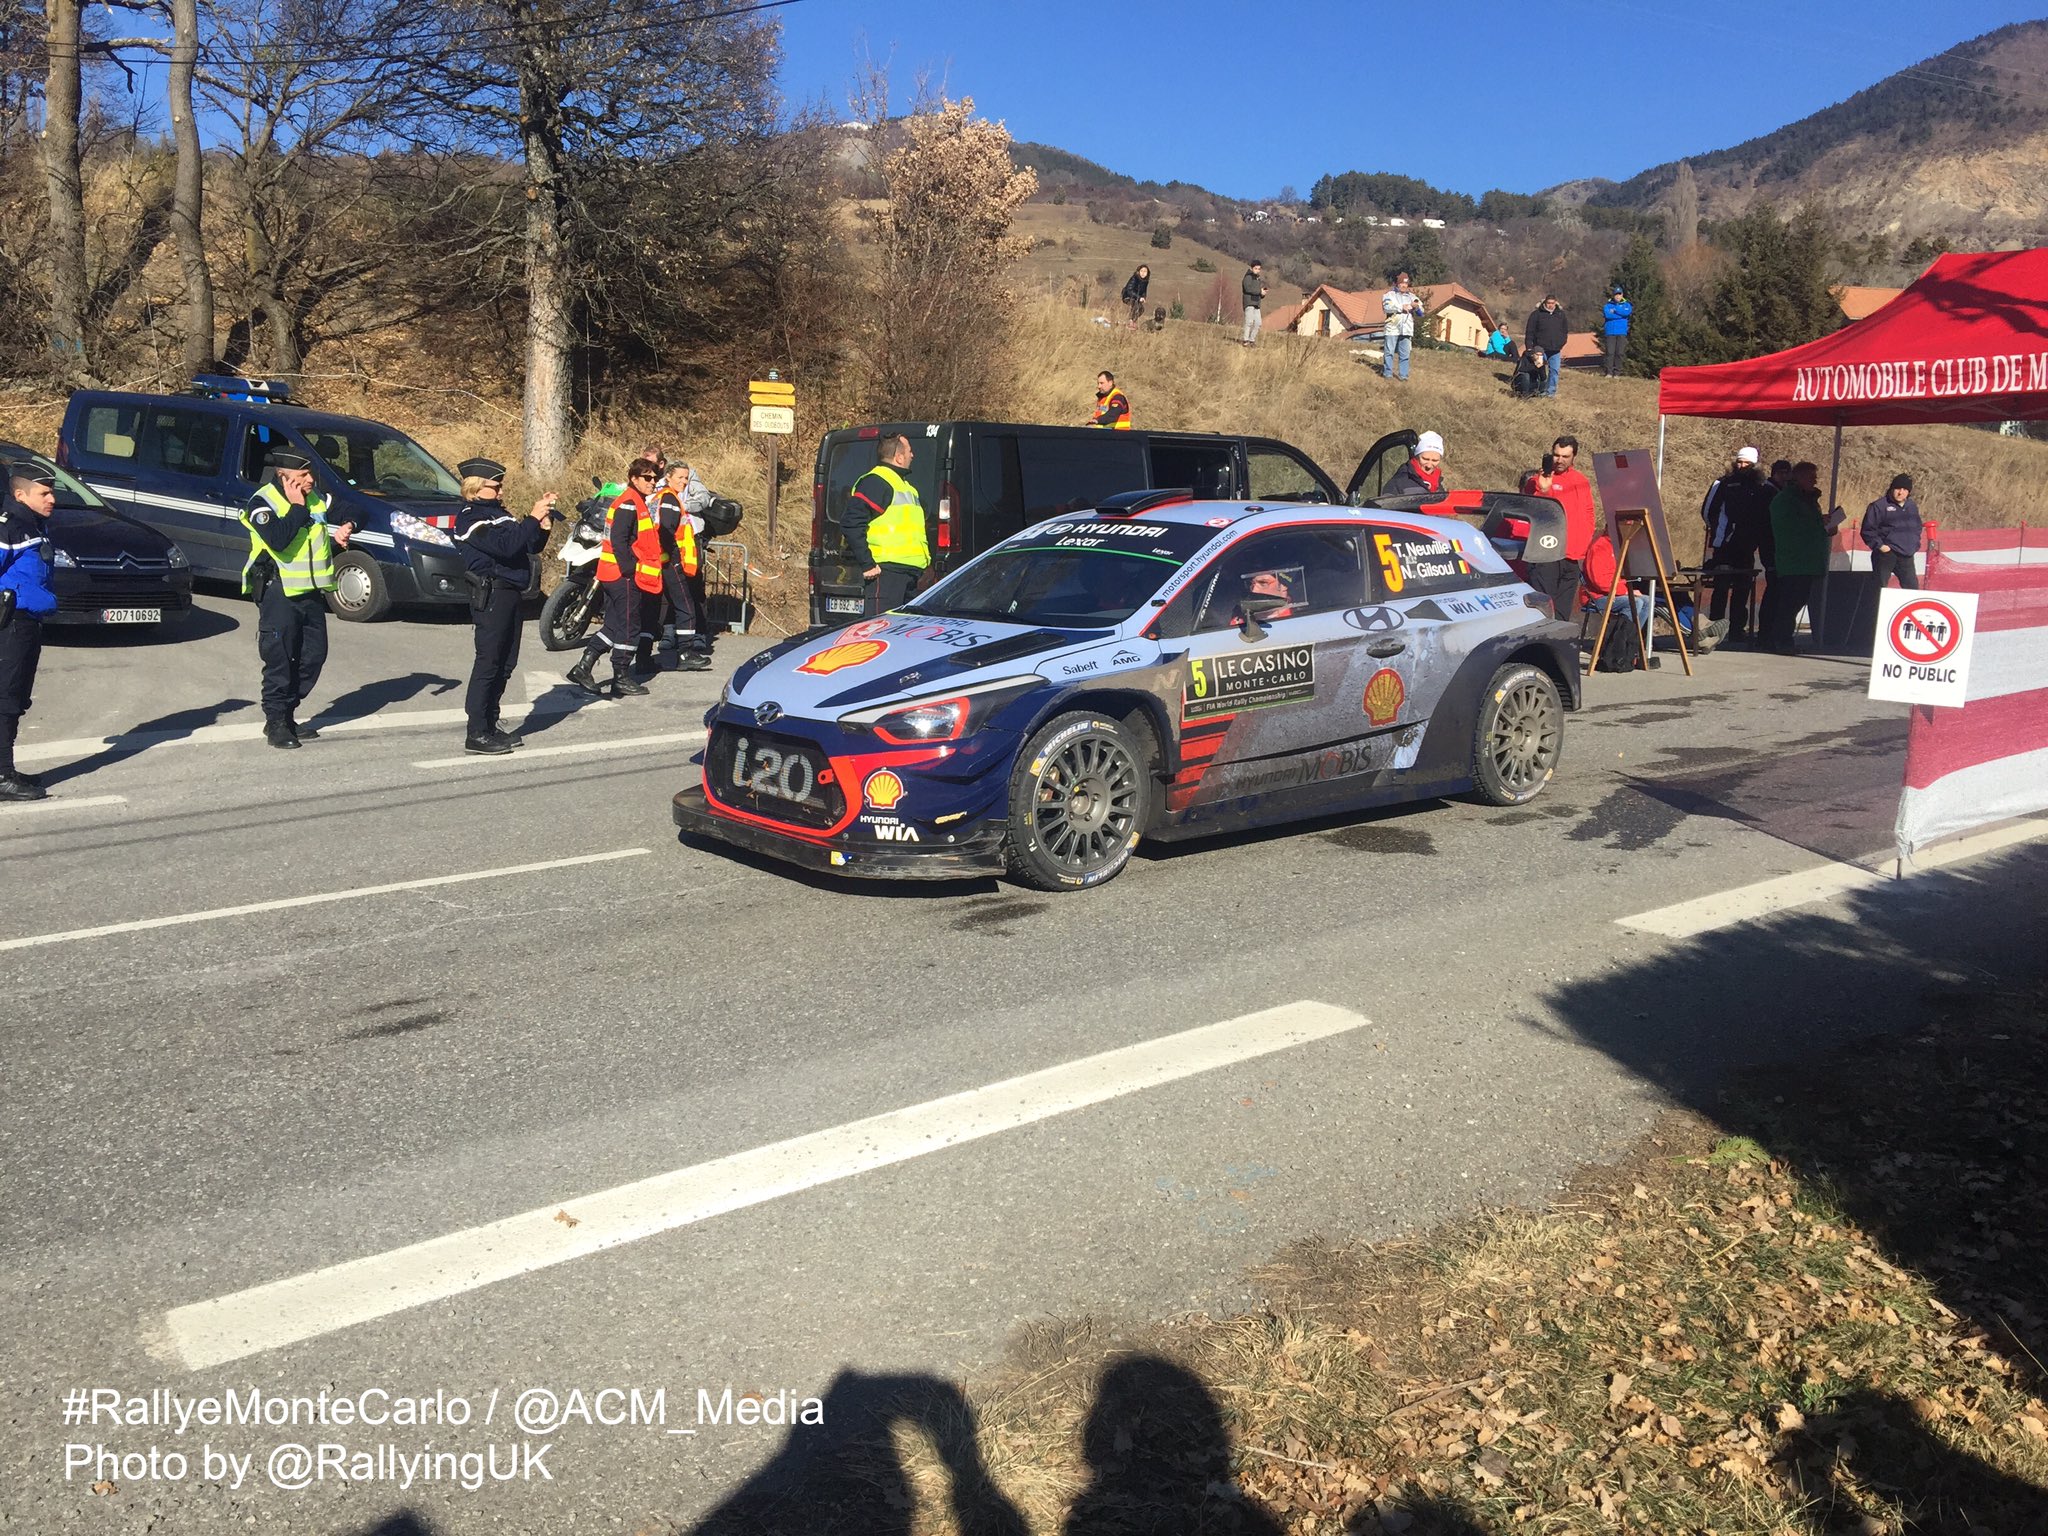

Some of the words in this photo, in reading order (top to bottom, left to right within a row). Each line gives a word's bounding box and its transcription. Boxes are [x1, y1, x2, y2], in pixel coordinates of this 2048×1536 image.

[1793, 360, 1926, 401] AUTOMOBILE
[1931, 355, 1987, 395] CLUB
[1991, 354, 2023, 392] DE
[1071, 523, 1169, 538] HYUNDAI
[1055, 536, 1105, 547] Lexar
[1392, 543, 1405, 558] T.
[1405, 541, 1450, 557] Neuville
[1162, 529, 1239, 598] motorsport.hyundai.com
[1373, 533, 1404, 592] 5
[1400, 564, 1416, 579] N.
[1417, 560, 1456, 578] Gilsoul
[1494, 599, 1518, 608] STEEL
[110, 609, 159, 622] 20710692
[901, 616, 974, 627] HYUNDAI
[876, 623, 992, 647] MOBIS
[1063, 661, 1099, 675] Sabelt
[1112, 655, 1141, 666] AMG
[1191, 660, 1207, 697] 5
[1218, 660, 1237, 679] LE
[1240, 649, 1310, 675] CASINO
[1883, 664, 1903, 679] NO
[1908, 666, 1957, 684] PUBLIC
[1206, 702, 1216, 711] FIA
[1044, 722, 1089, 755] MICHELIN
[733, 737, 813, 801] i20
[1297, 745, 1372, 784] MOBIS
[860, 815, 899, 825] HYUNDAI
